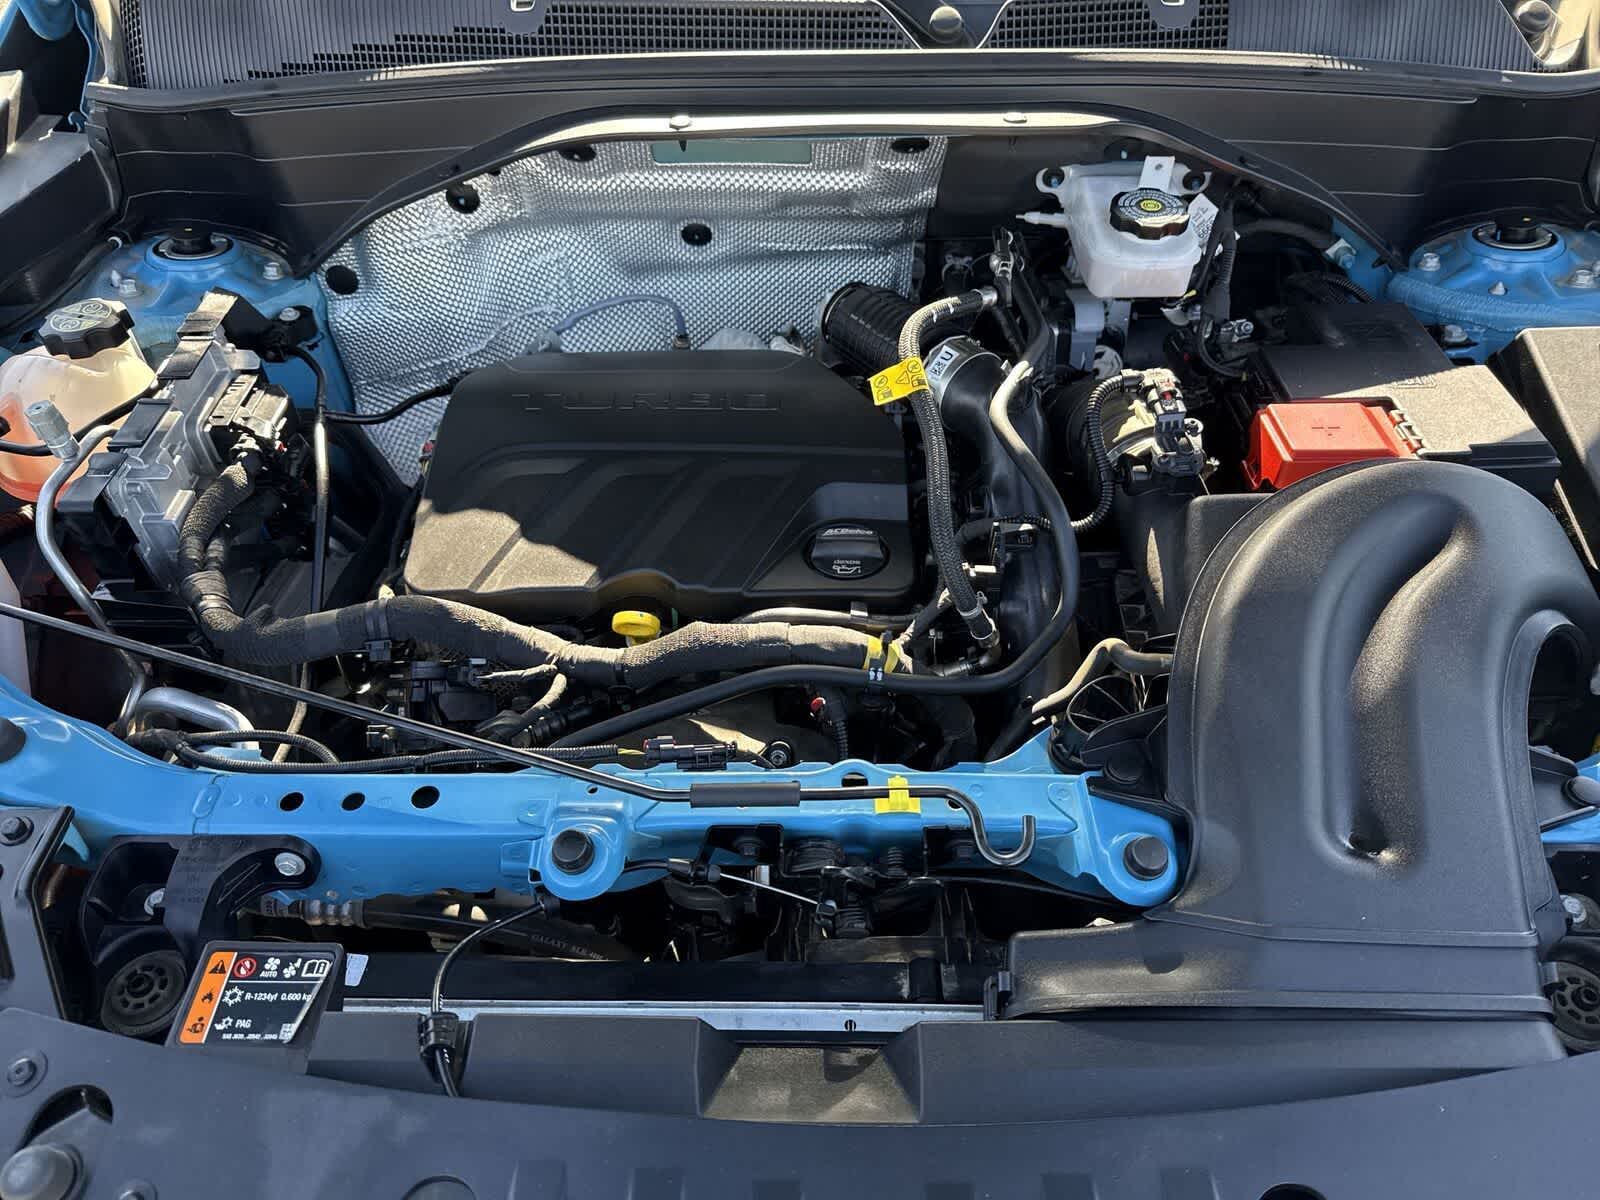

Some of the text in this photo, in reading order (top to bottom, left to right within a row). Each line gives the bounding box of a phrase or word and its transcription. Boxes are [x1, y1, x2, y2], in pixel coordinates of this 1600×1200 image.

[510, 393, 782, 411] TURBO
[822, 528, 874, 537] ACDelco
[259, 970, 278, 978] AUTO
[244, 993, 278, 1002] R-1234yf
[280, 992, 302, 1001] 0.600
[235, 1018, 252, 1029] PAG
